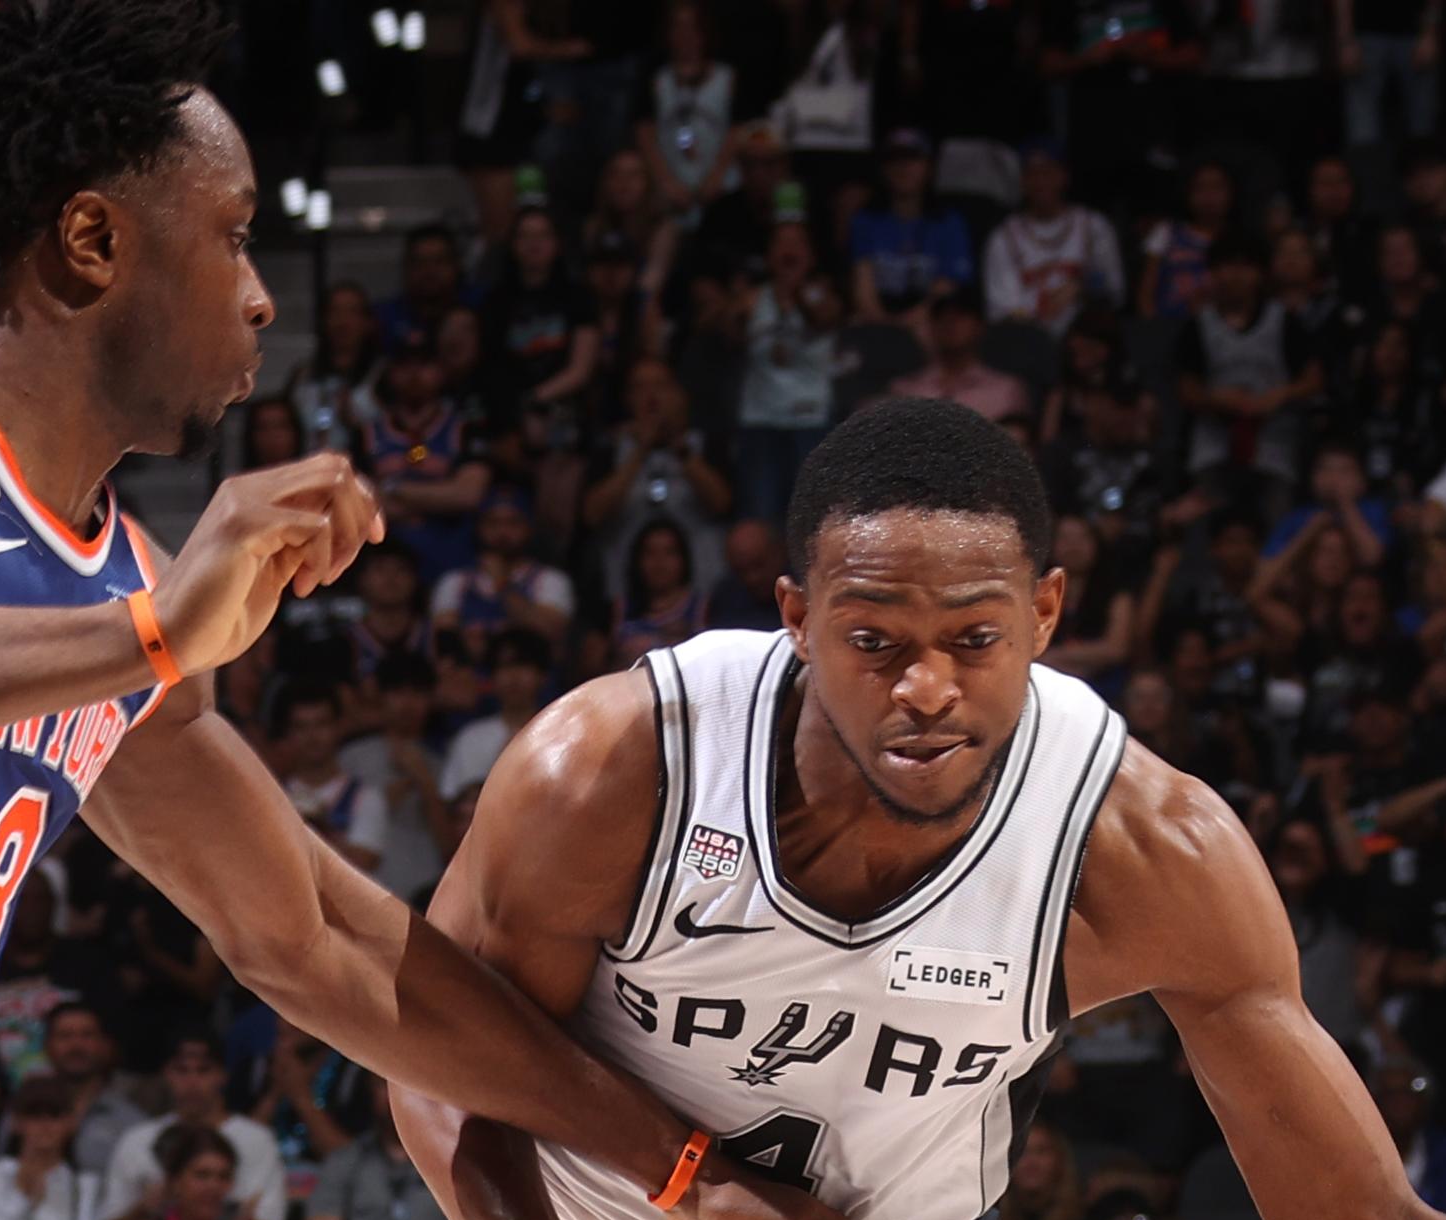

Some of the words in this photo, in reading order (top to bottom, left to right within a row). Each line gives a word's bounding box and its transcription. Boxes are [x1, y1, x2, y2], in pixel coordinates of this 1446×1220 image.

[41, 698, 129, 807] YOR
[684, 849, 737, 877] 250
[694, 827, 739, 853] USA
[906, 963, 992, 989] LEDGER
[614, 971, 1012, 1098] SPURS
[717, 1106, 829, 1196] 4
